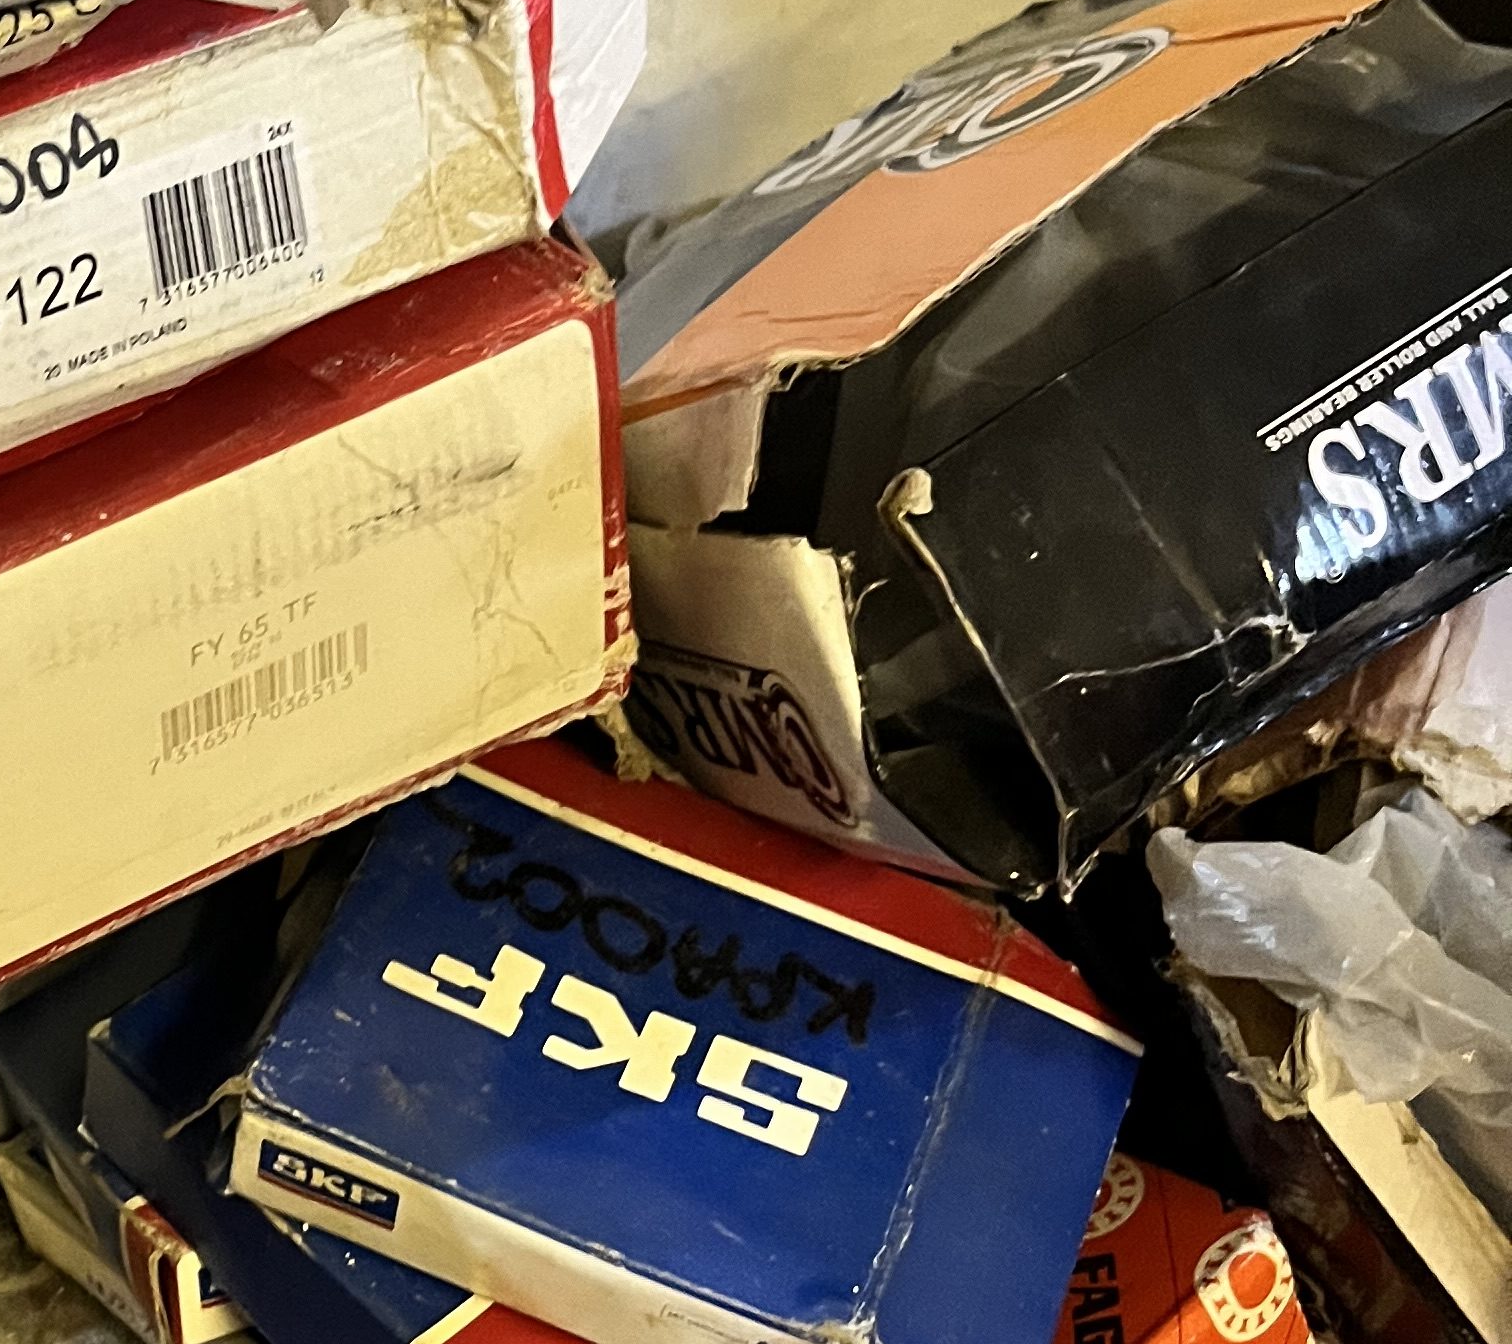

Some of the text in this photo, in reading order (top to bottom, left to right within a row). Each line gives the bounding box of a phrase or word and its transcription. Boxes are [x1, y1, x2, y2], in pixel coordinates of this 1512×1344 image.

[1266, 287, 1509, 452] BALL AND ROLLER BEARINGS
[190, 631, 225, 666] FY
[238, 613, 271, 646] 65
[283, 591, 319, 624] TF
[382, 944, 849, 1157] SKF
[271, 1151, 389, 1210] SKF
